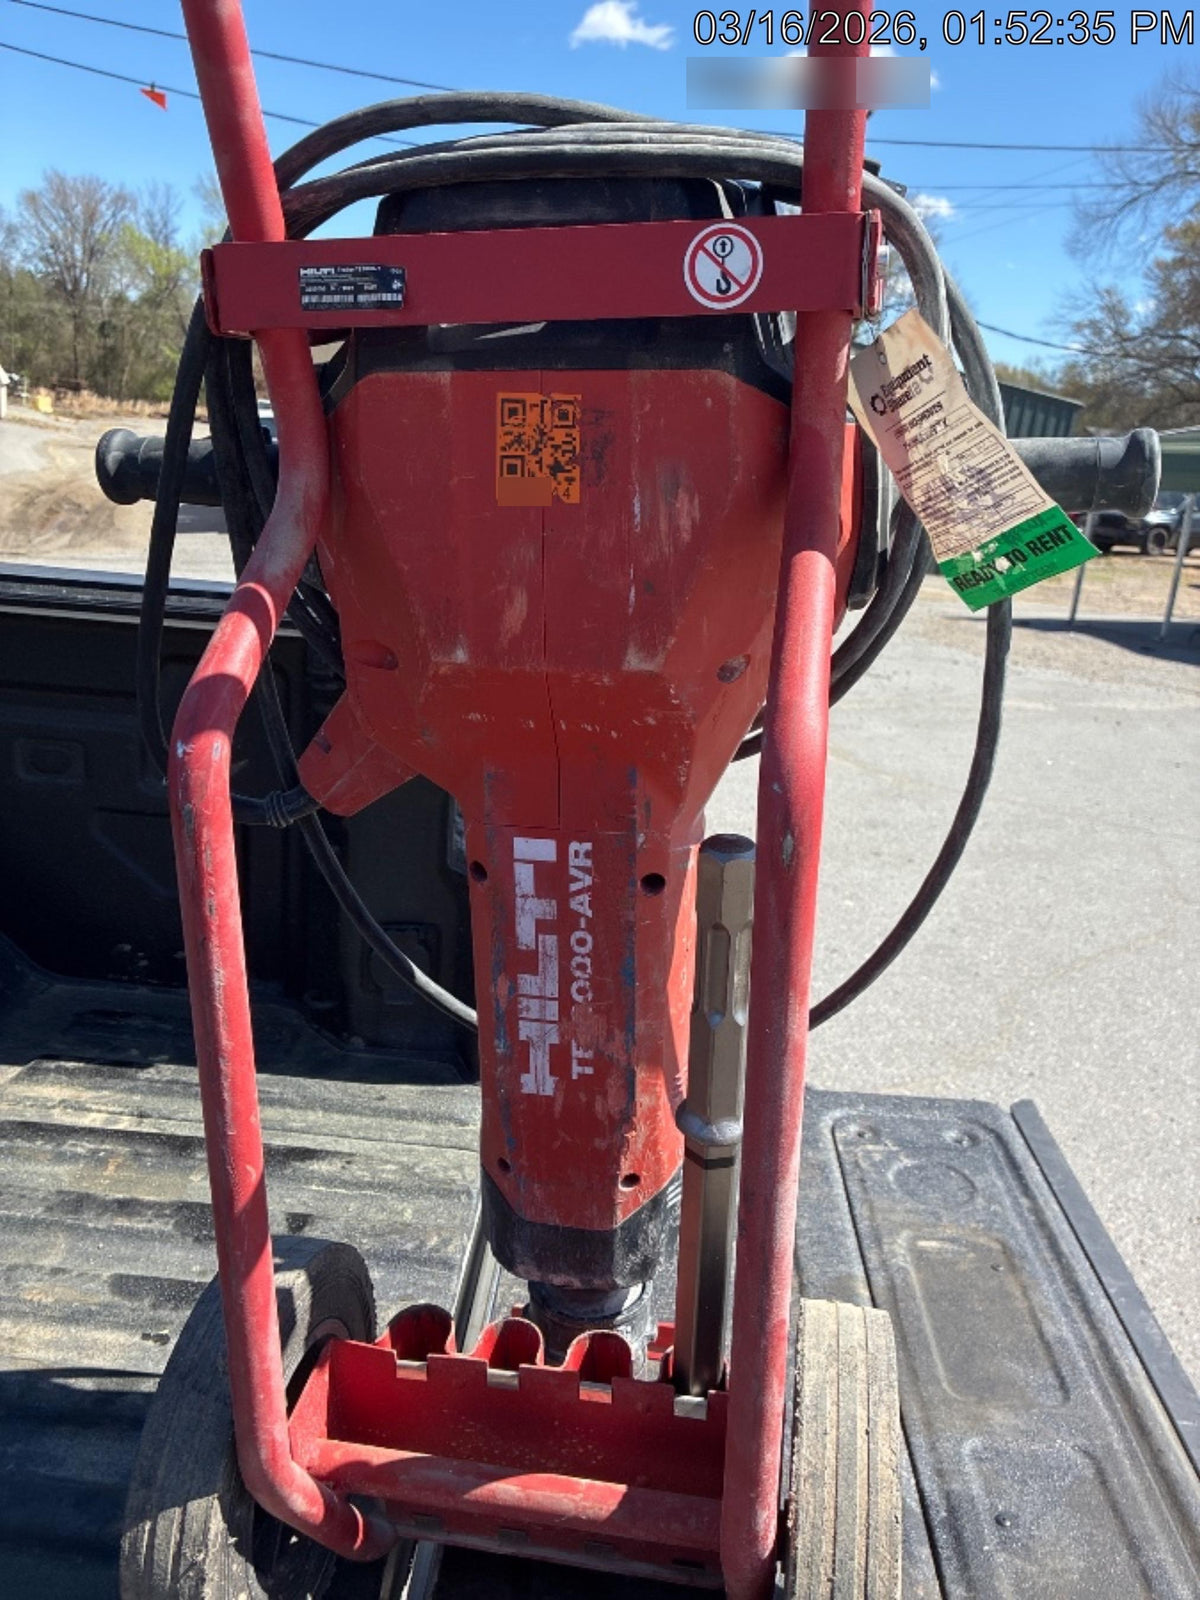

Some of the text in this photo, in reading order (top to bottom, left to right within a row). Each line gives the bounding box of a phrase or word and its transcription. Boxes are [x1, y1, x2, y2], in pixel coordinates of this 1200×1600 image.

[952, 558, 1004, 592] READY
[1005, 547, 1028, 567] TO
[1024, 524, 1074, 557] RENT
[513, 837, 559, 1096] HILTI
